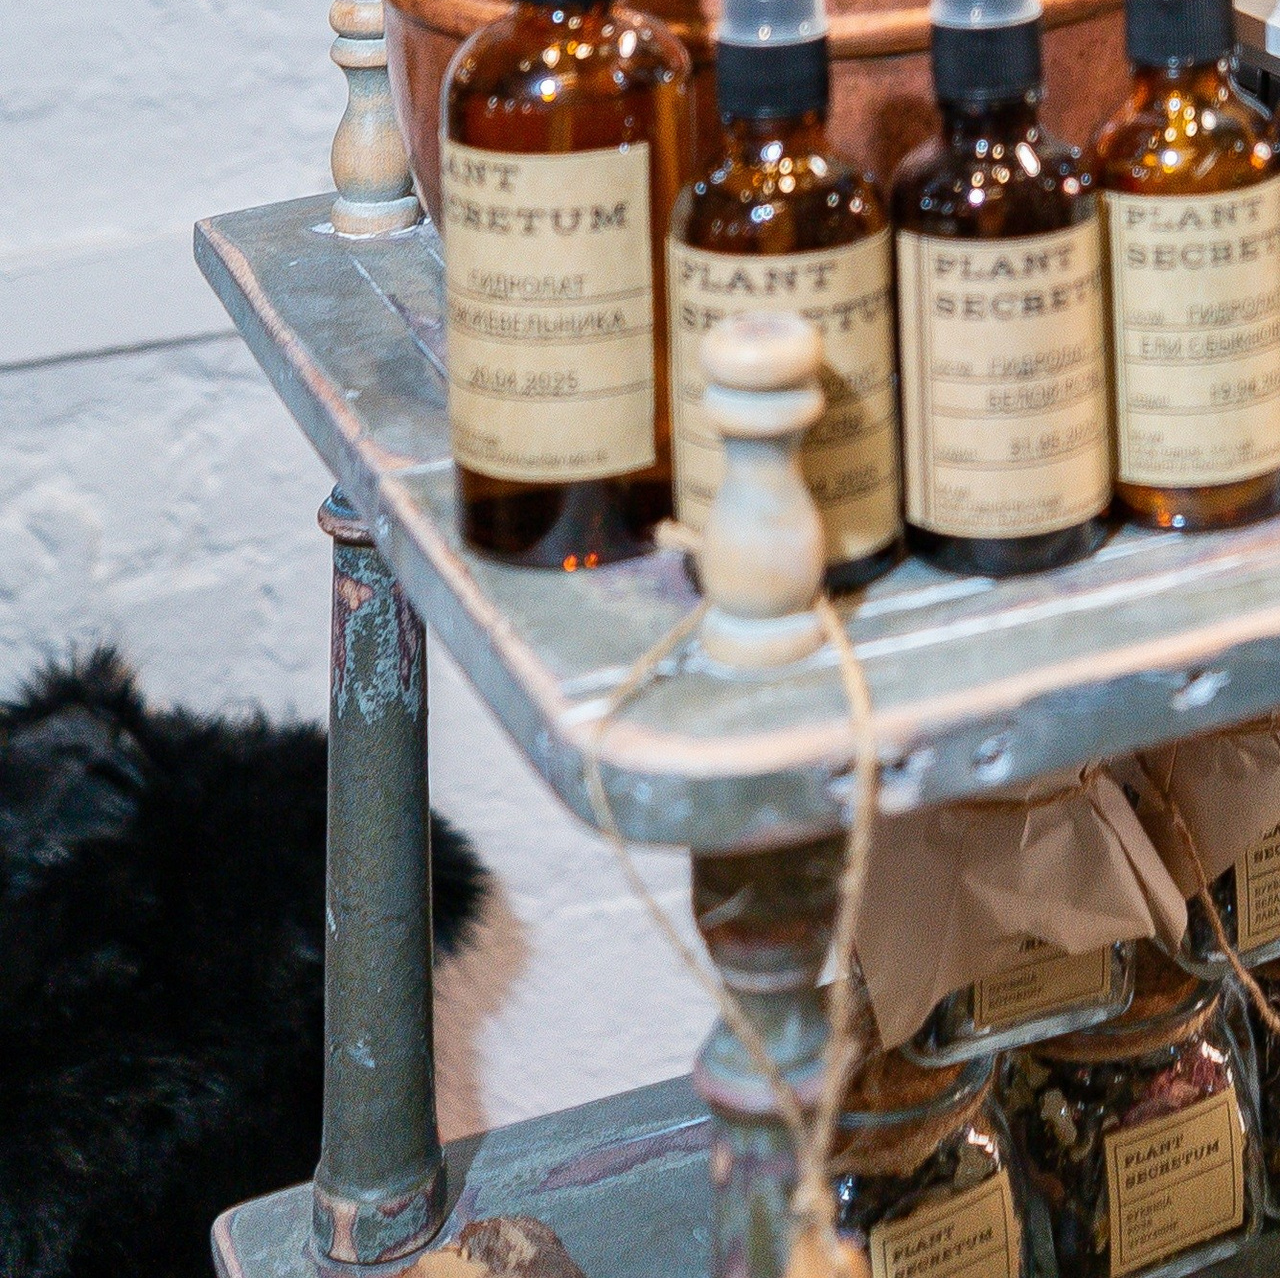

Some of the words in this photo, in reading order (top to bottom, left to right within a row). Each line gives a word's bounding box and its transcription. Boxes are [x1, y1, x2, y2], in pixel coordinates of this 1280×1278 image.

[1126, 198, 1260, 232] PLANT
[682, 259, 838, 294] PLANT
[934, 245, 1075, 280] PLANT
[1124, 1132, 1184, 1170] PLANT
